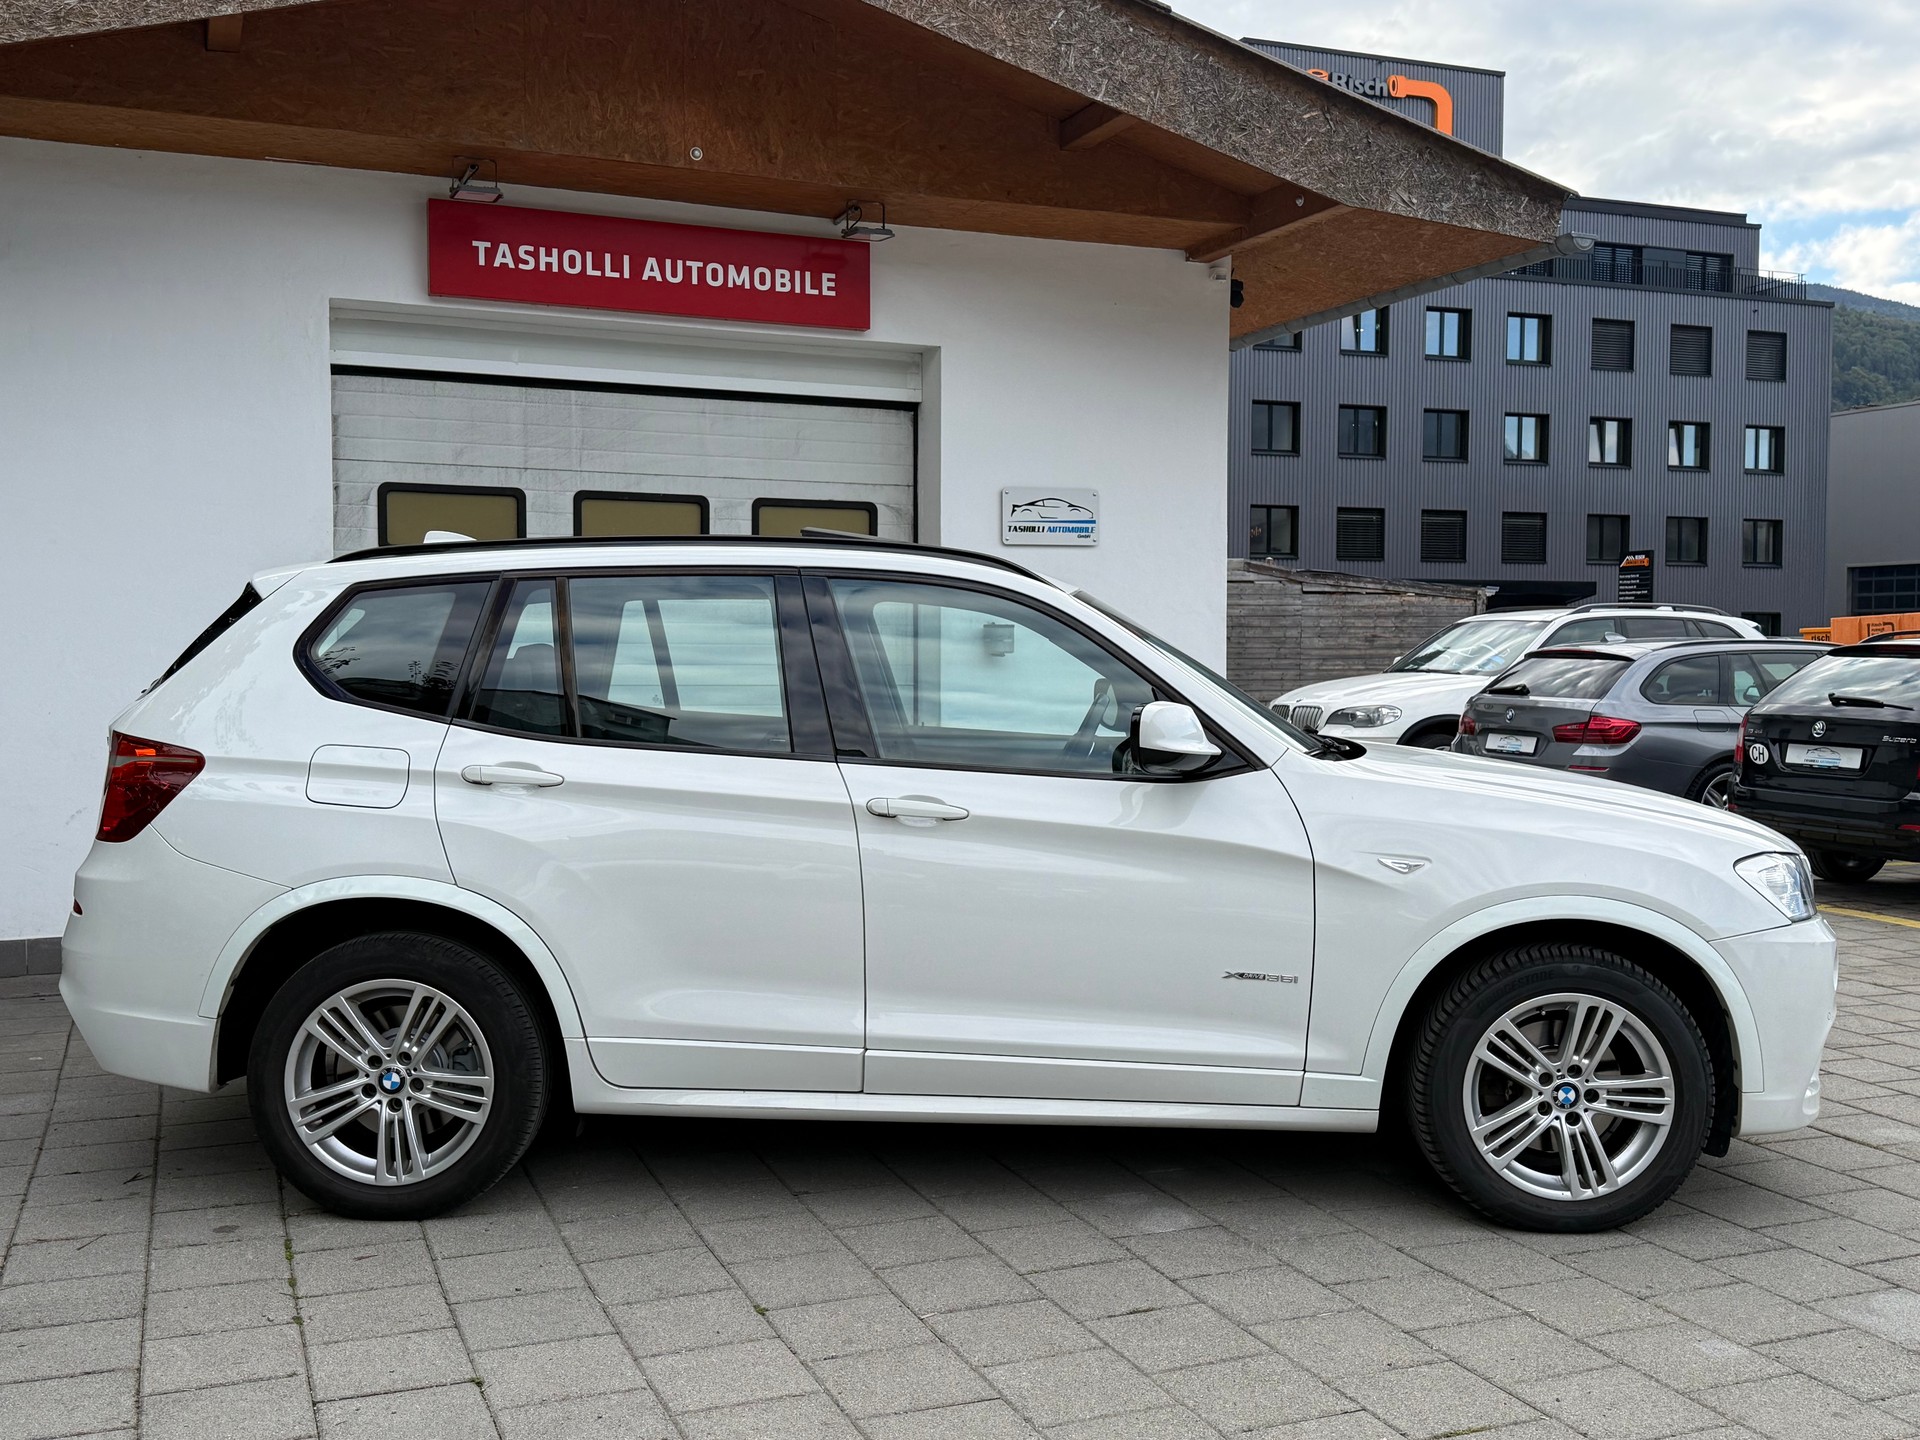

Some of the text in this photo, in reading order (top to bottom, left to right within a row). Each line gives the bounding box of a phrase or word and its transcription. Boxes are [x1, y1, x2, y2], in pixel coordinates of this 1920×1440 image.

[1332, 71, 1388, 97] Risch
[472, 240, 837, 297] TASHOLLI AUTOMOBILE
[1007, 525, 1095, 534] TASHOLLI AUTOMOBILE
[1811, 634, 1830, 642] risch
[1751, 747, 1765, 763] CH
